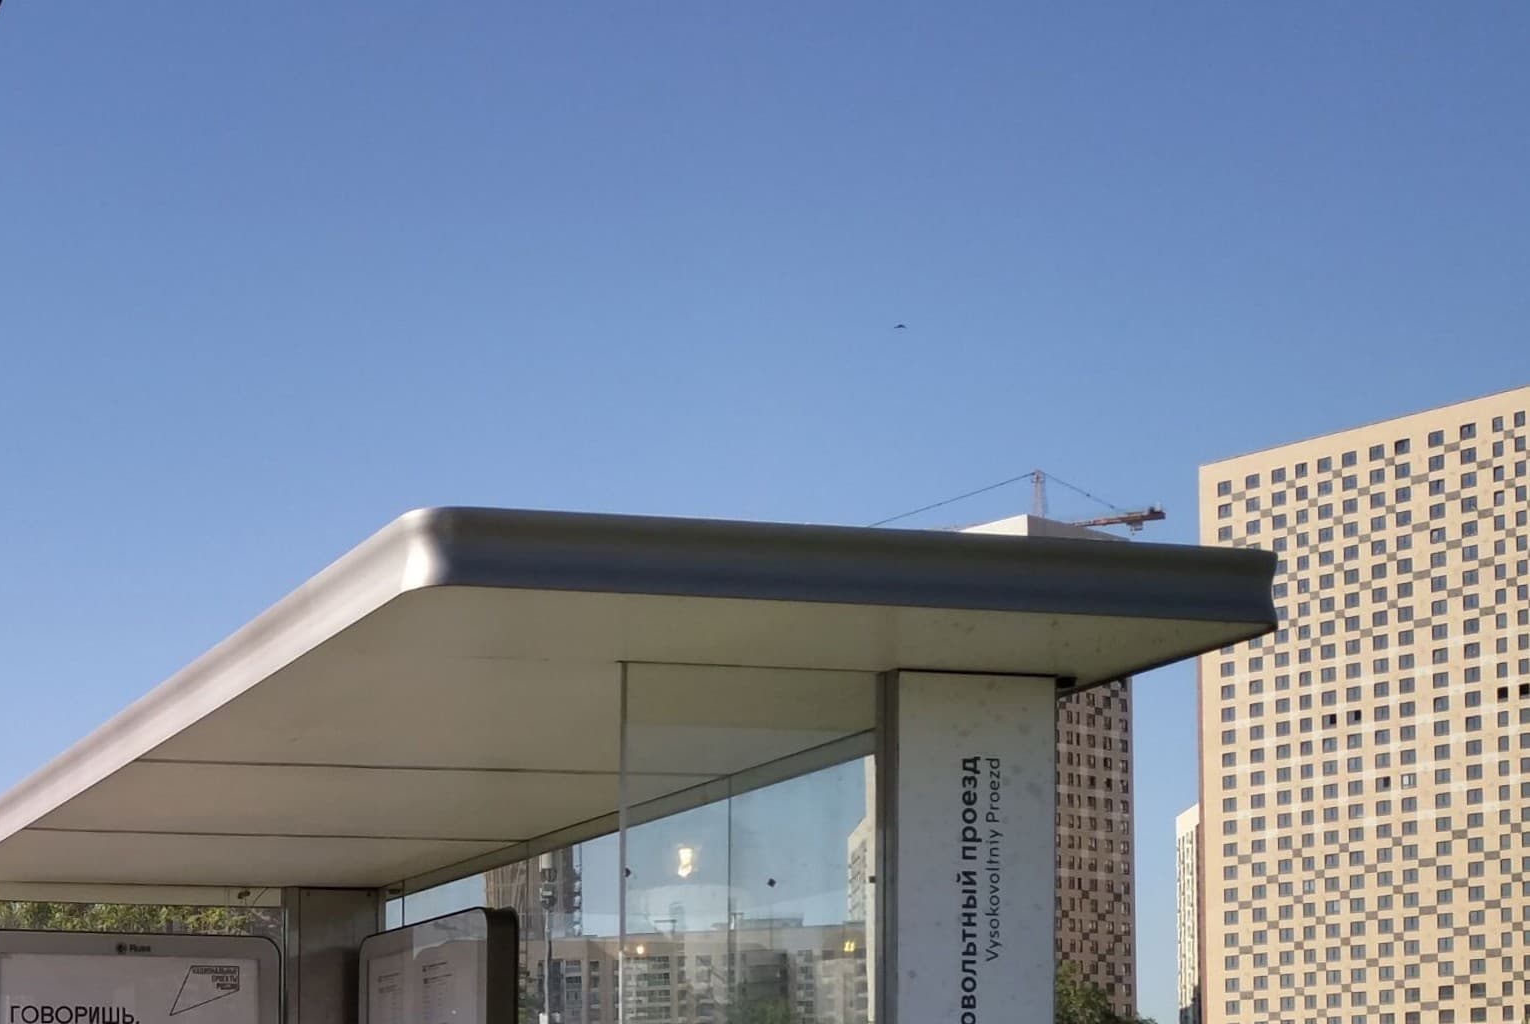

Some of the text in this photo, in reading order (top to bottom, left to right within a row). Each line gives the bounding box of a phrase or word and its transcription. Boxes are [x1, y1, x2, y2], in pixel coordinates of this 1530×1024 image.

[961, 755, 982, 861] проезд
[986, 757, 1003, 962] Vysokovoltniy Proezd
